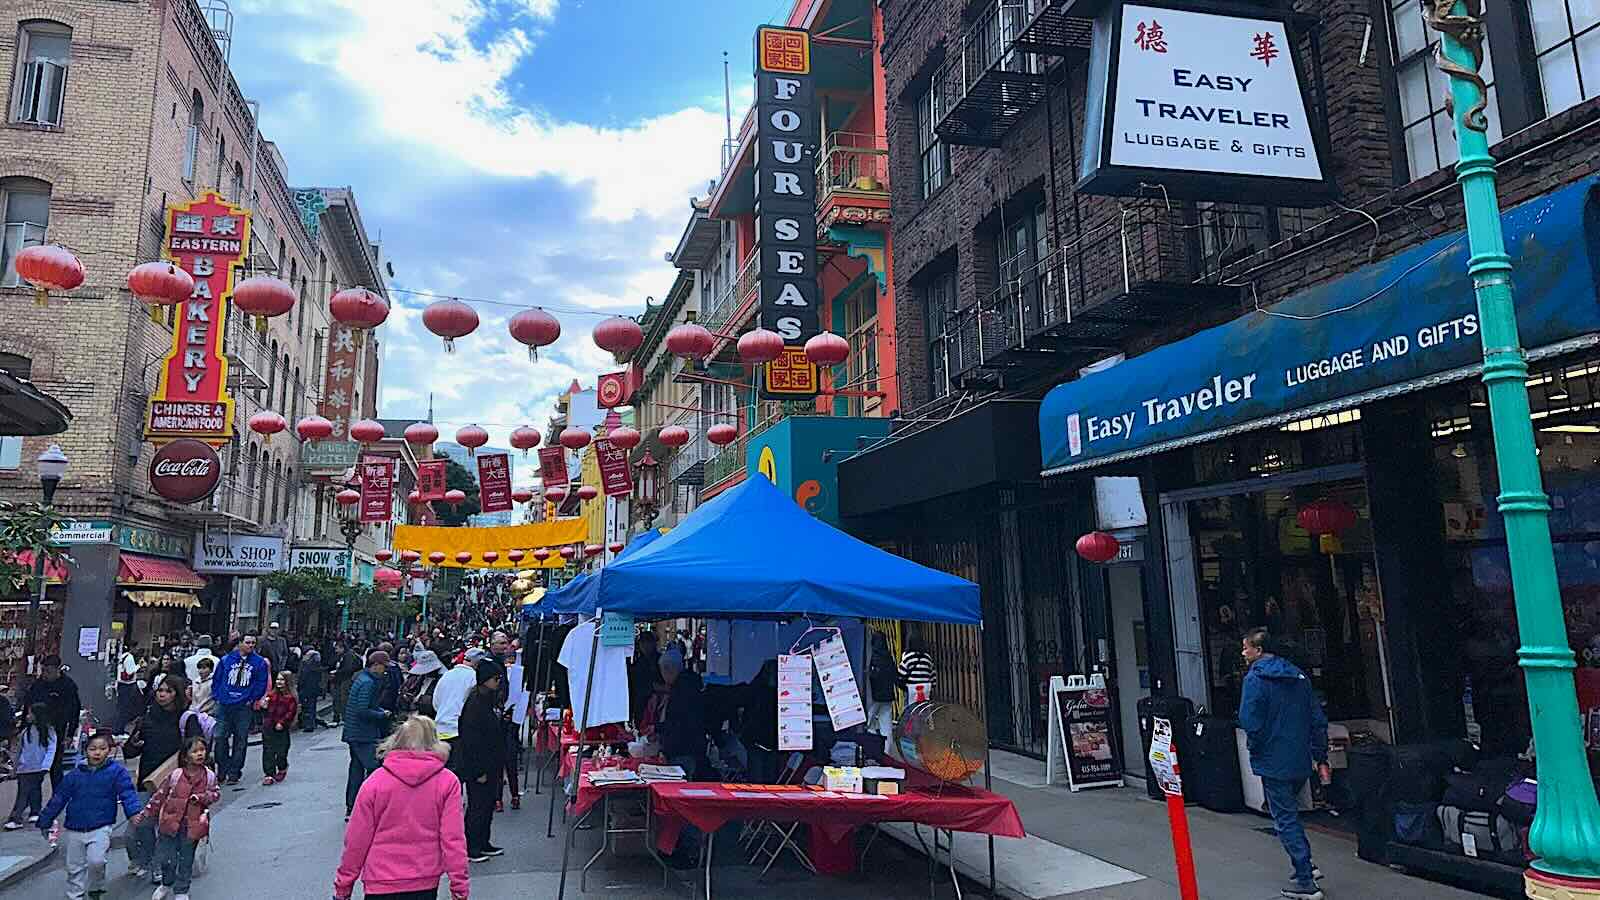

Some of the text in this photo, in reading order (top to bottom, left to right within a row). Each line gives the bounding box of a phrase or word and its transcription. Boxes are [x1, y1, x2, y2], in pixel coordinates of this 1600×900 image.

[1134, 19, 1280, 67] 德 華
[1173, 68, 1253, 92] EASY
[1136, 98, 1291, 129] TRAVELER
[771, 78, 804, 196] FOUR
[1124, 132, 1306, 158] LUGGAGE & GIFTS
[171, 237, 240, 252] EASTERN
[774, 218, 807, 340] SEAS
[183, 255, 214, 392] BAKERY
[1286, 314, 1478, 387] LUGGAGE AND GIFTS
[154, 403, 224, 417] CHINESE &
[1087, 373, 1257, 442] Easy Traveler
[153, 416, 223, 429] AMERICAN FOOD
[154, 458, 212, 477] Coca-Cola
[53, 531, 105, 540] Commercial
[203, 544, 276, 561] WOK SHOP
[204, 559, 274, 569] www.wokshop.com
[298, 551, 331, 565] SNOW
